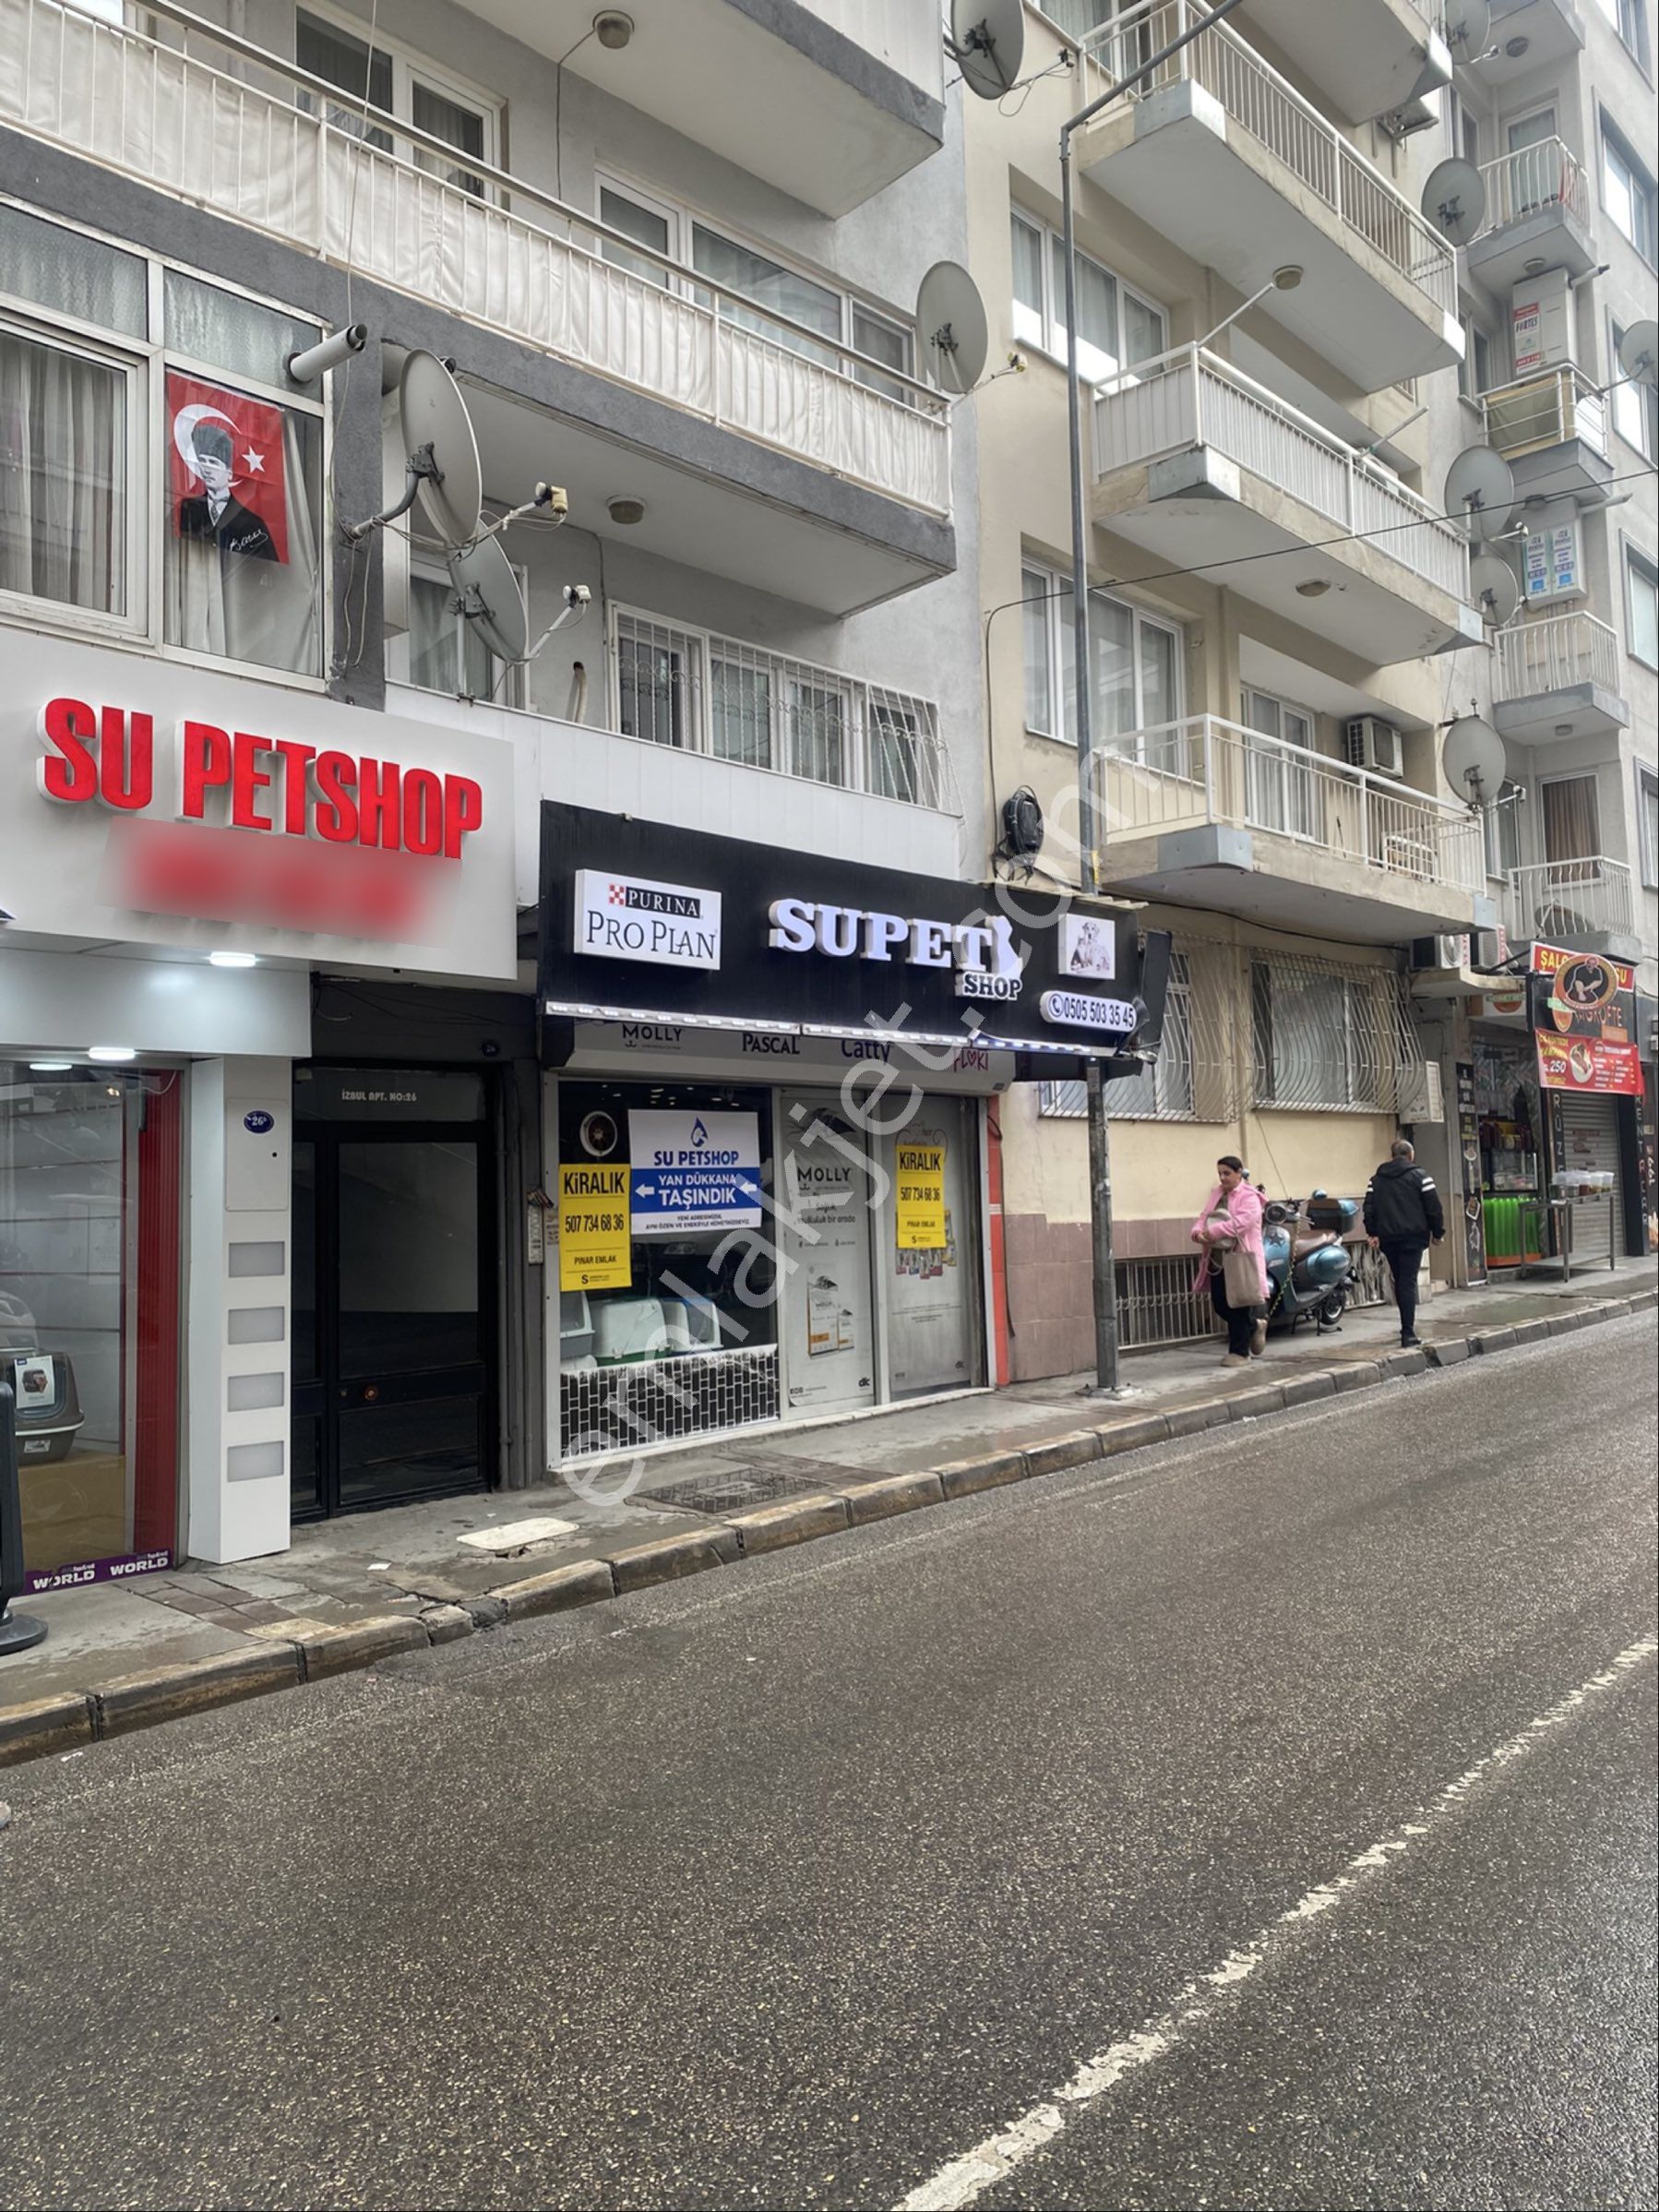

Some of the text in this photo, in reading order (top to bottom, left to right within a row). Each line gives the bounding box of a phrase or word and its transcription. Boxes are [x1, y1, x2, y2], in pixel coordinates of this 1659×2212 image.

[43, 698, 483, 859] SU PETSHOP
[627, 889, 699, 916] PURINA
[586, 910, 716, 960] PRO PLAN
[770, 898, 993, 973] SUPET
[964, 973, 1023, 1000] SHOP
[1064, 997, 1134, 1028] 0505 503 35 45
[622, 1023, 682, 1041] MOLLY
[742, 1033, 801, 1055] PASCAL
[841, 1039, 891, 1065] Catty
[653, 1150, 739, 1166] SU PETSHOP
[658, 1171, 737, 1187] YAN DÜKKANA
[797, 1166, 852, 1182] MOLLY
[658, 1188, 736, 1210] TAŞINDIK
[565, 1214, 581, 1233] 507
[583, 1214, 599, 1233] 734
[601, 1214, 612, 1231] 68
[613, 1213, 625, 1231] 36
[574, 1255, 617, 1265] PINAR EMLAK
[110, 1557, 169, 1576] WORLD
[33, 1570, 95, 1590] WORLD
